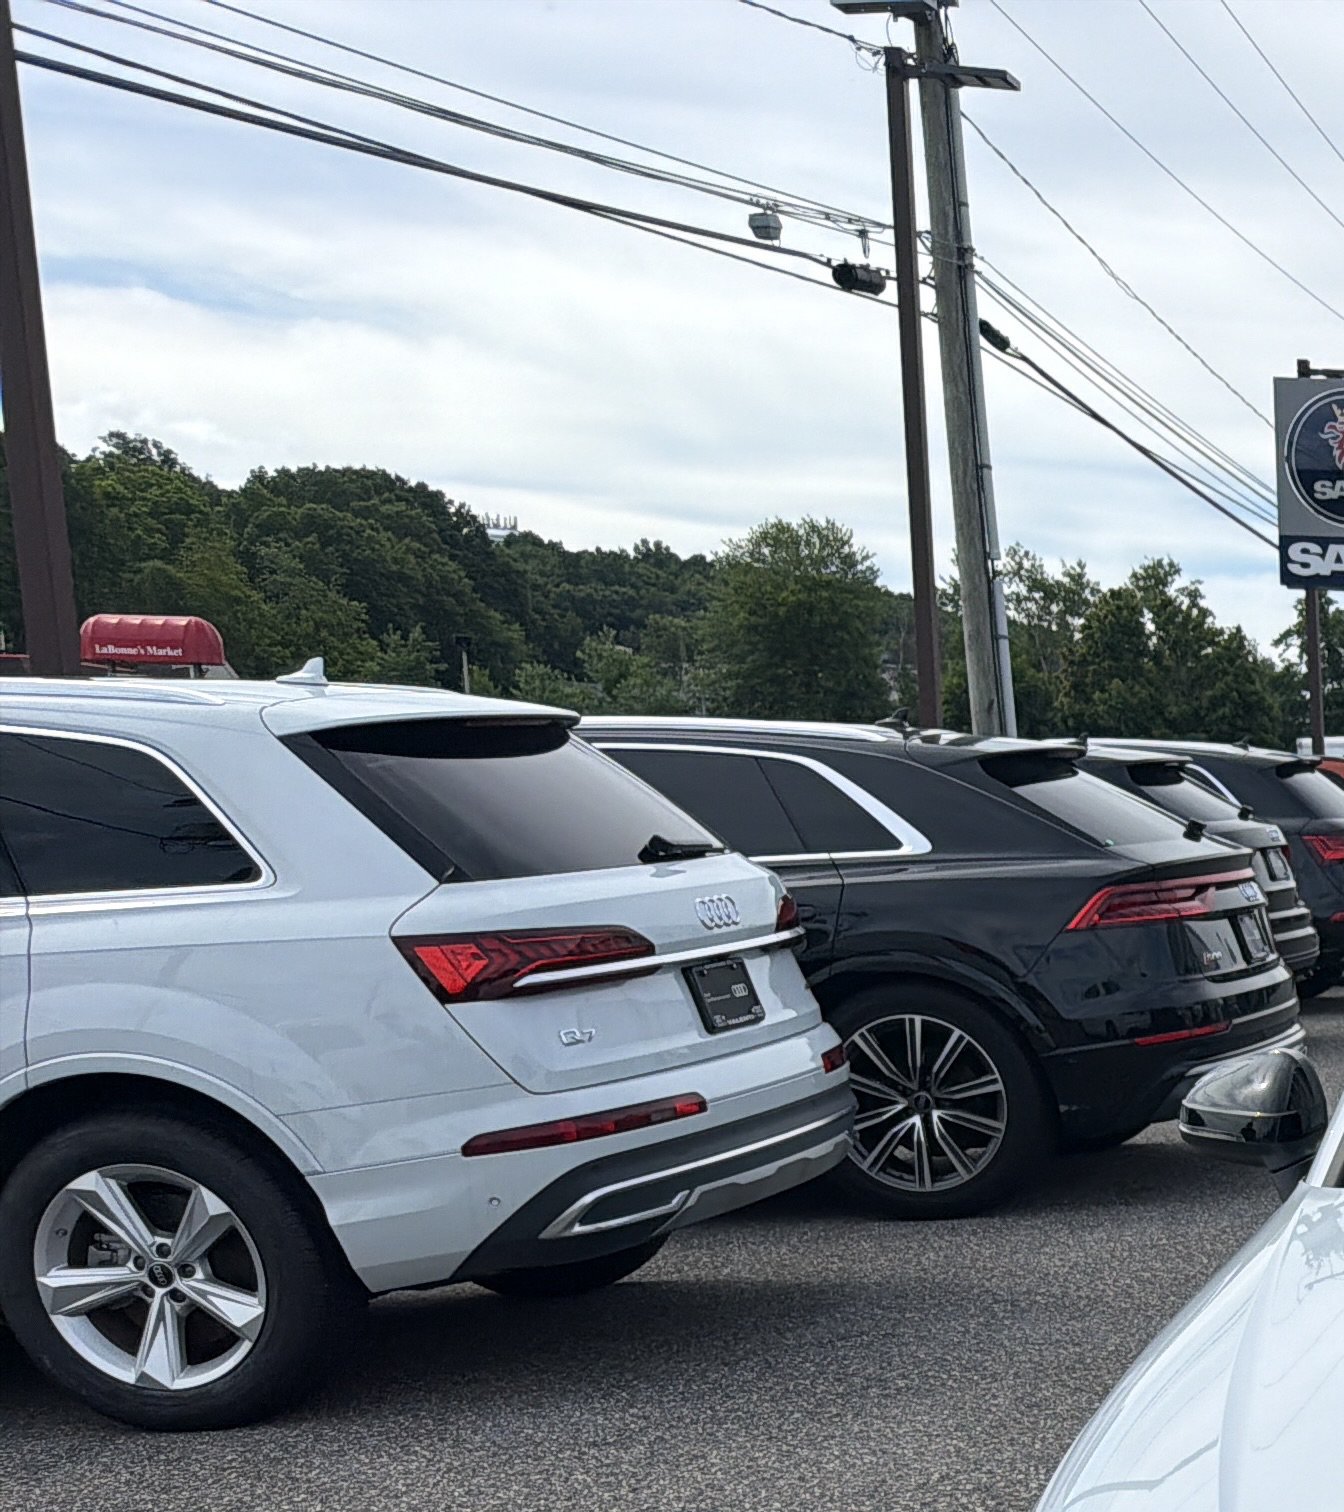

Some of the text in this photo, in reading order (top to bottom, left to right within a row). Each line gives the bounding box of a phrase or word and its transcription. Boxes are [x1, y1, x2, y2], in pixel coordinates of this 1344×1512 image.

[95, 644, 183, 656] LaBonne's Market
[560, 1027, 596, 1046] Q7
